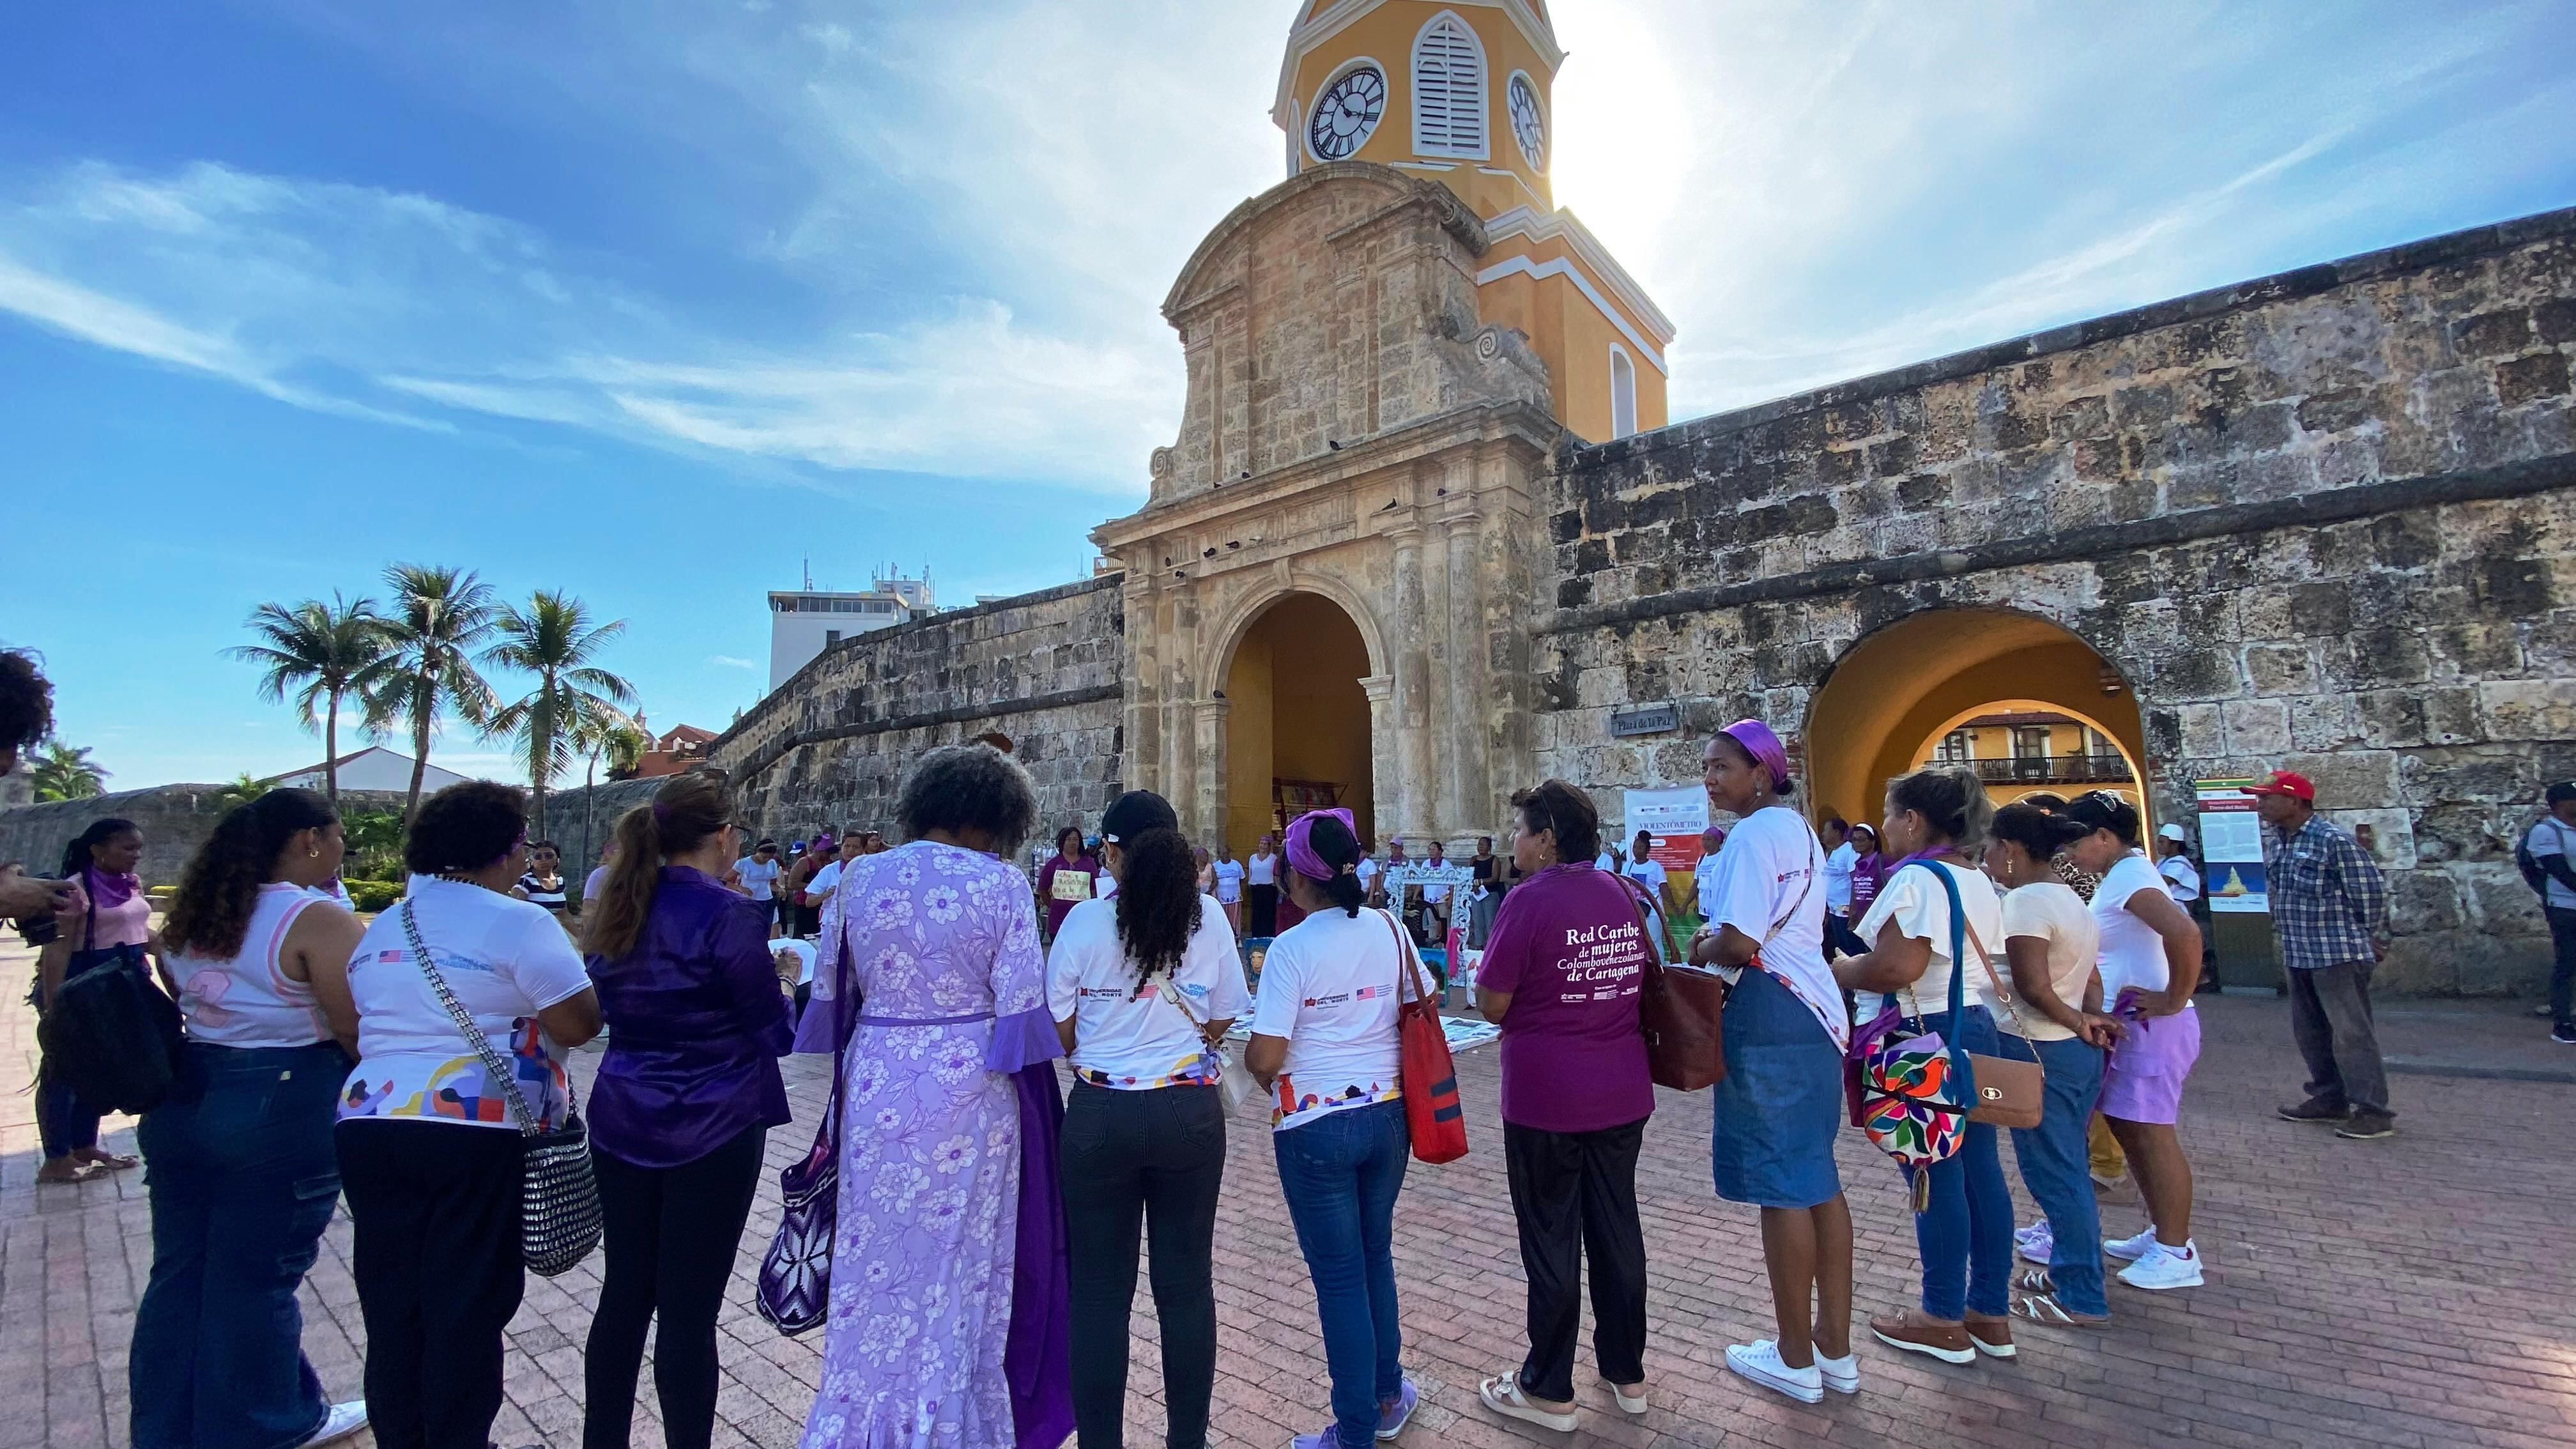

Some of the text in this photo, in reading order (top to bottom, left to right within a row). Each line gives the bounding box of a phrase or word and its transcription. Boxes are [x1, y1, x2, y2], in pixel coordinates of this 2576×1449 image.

[1566, 921, 1639, 945] Red Caribe
[1579, 939, 1638, 958] de mujeres
[1557, 951, 1646, 969] Colombovenezolanas
[1567, 963, 1639, 982] de Cartagena
